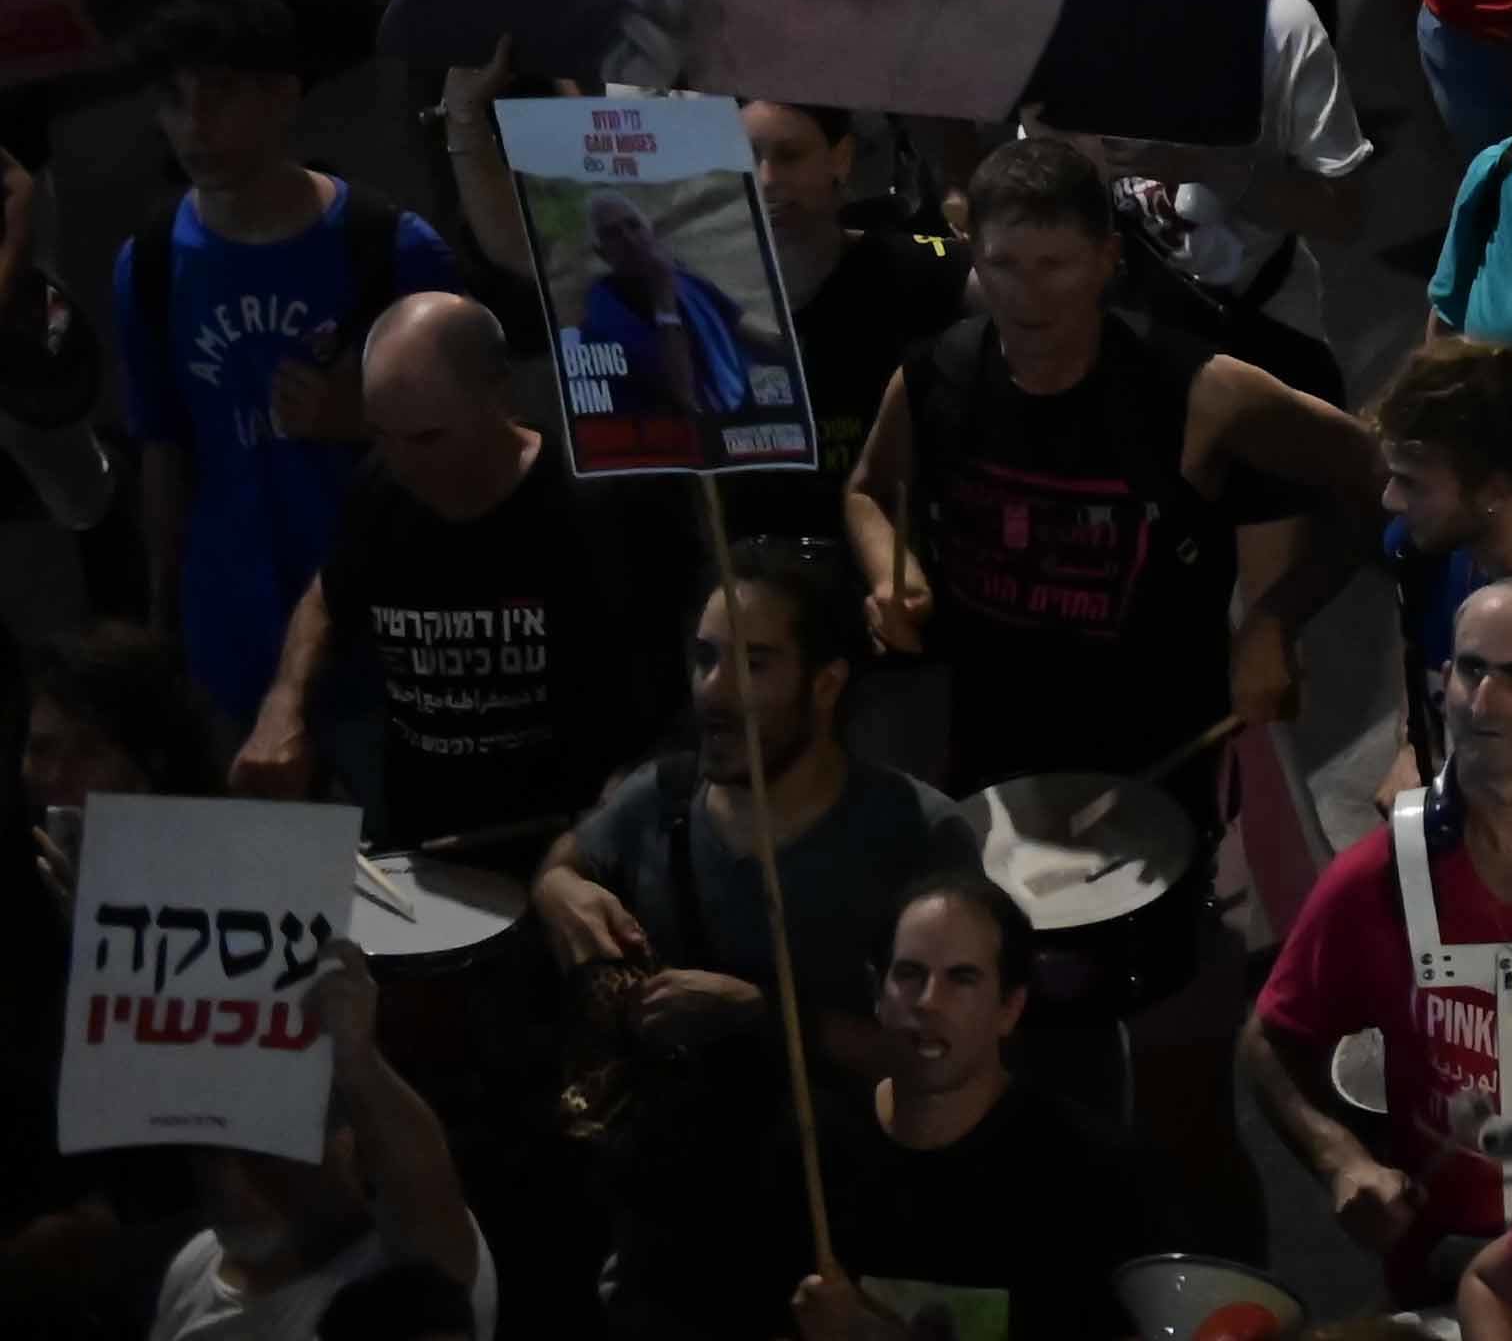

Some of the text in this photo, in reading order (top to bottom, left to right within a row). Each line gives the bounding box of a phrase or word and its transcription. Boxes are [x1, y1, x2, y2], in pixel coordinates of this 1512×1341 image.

[562, 340, 628, 377] BRING
[568, 376, 615, 414] HIM
[502, 607, 546, 642] אין
[411, 645, 547, 677] עם כיבוש
[96, 904, 333, 992] עסקה
[86, 994, 323, 1053] עכשיו
[1425, 996, 1499, 1059] PINK
